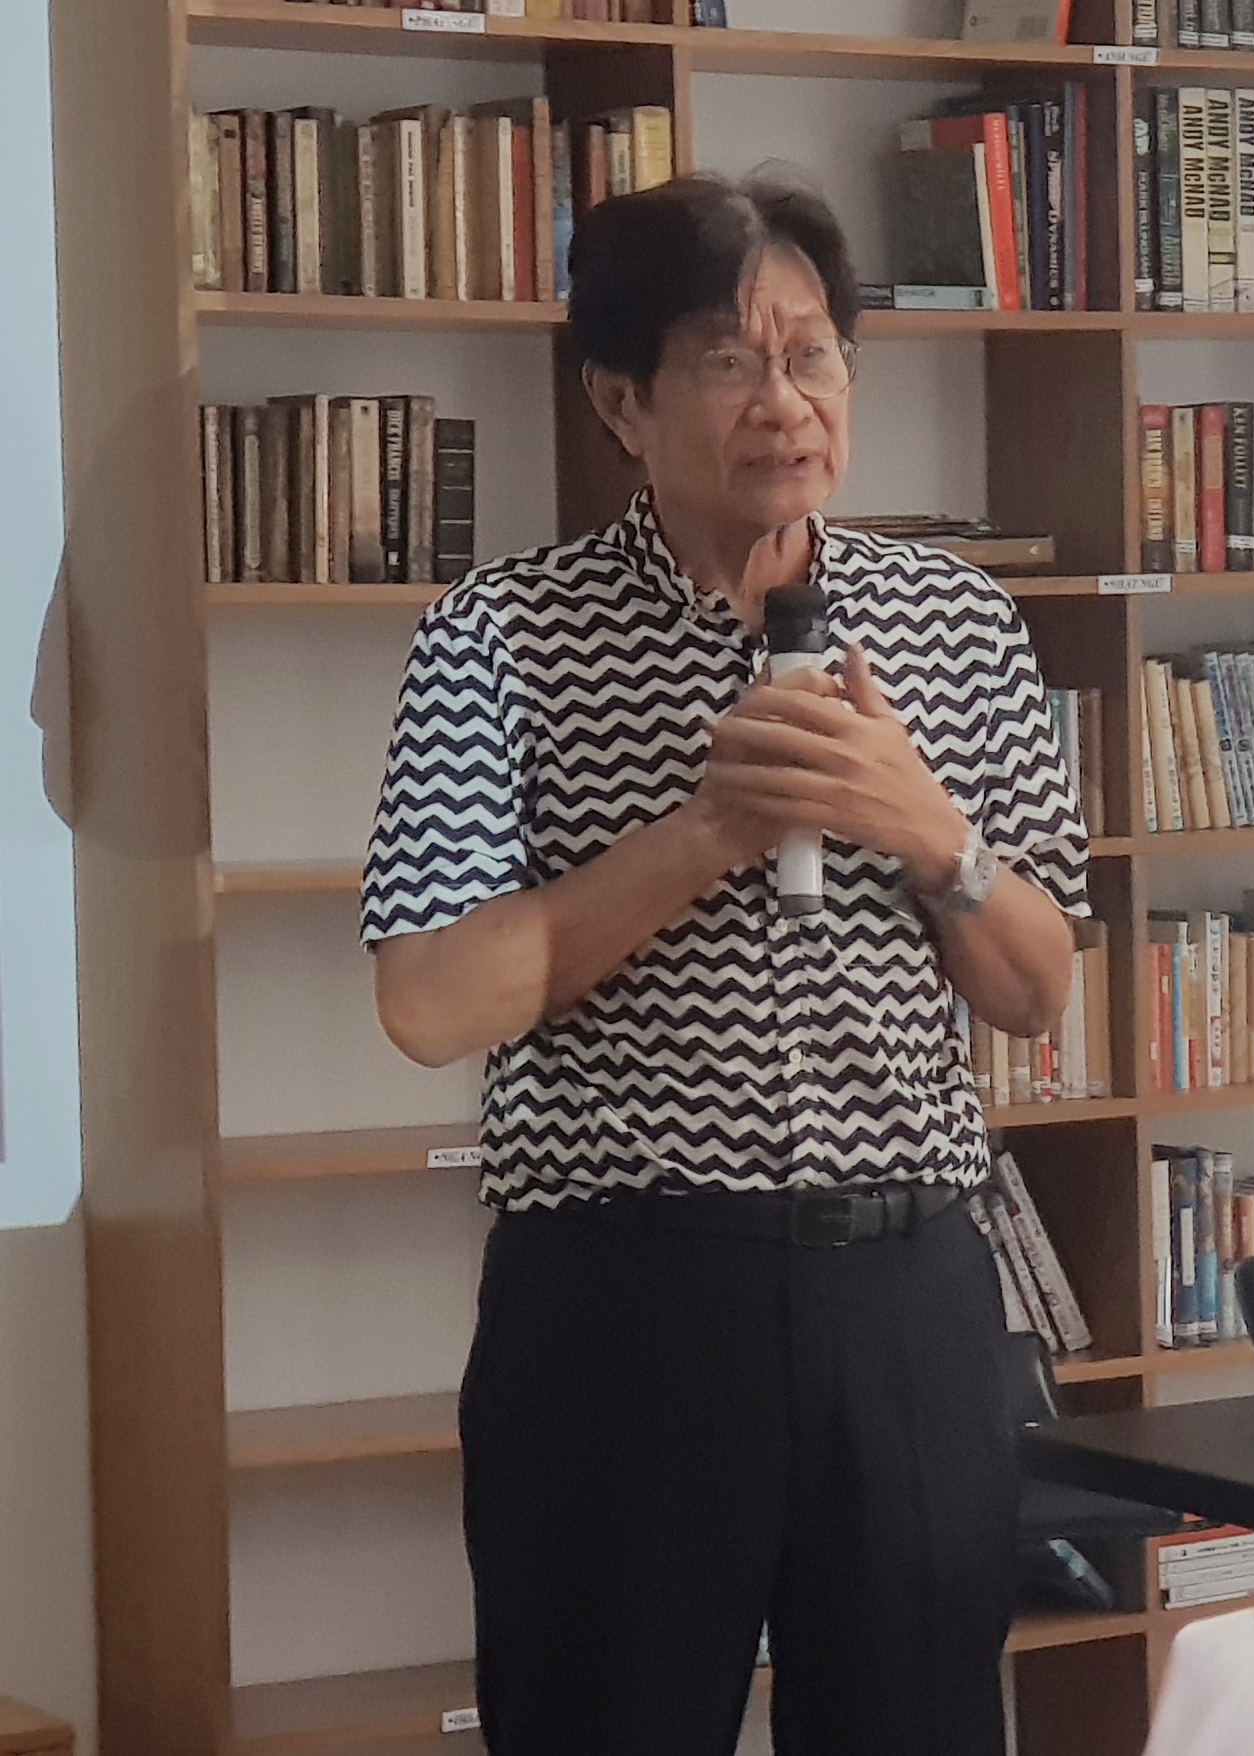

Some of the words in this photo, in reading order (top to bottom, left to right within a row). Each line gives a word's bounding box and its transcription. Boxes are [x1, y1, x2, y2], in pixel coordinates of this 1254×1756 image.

[1183, 105, 1204, 151] ANDY
[1207, 99, 1230, 149] ANDY
[1233, 407, 1248, 435] KEN
[1233, 437, 1248, 490] FOLLETT
